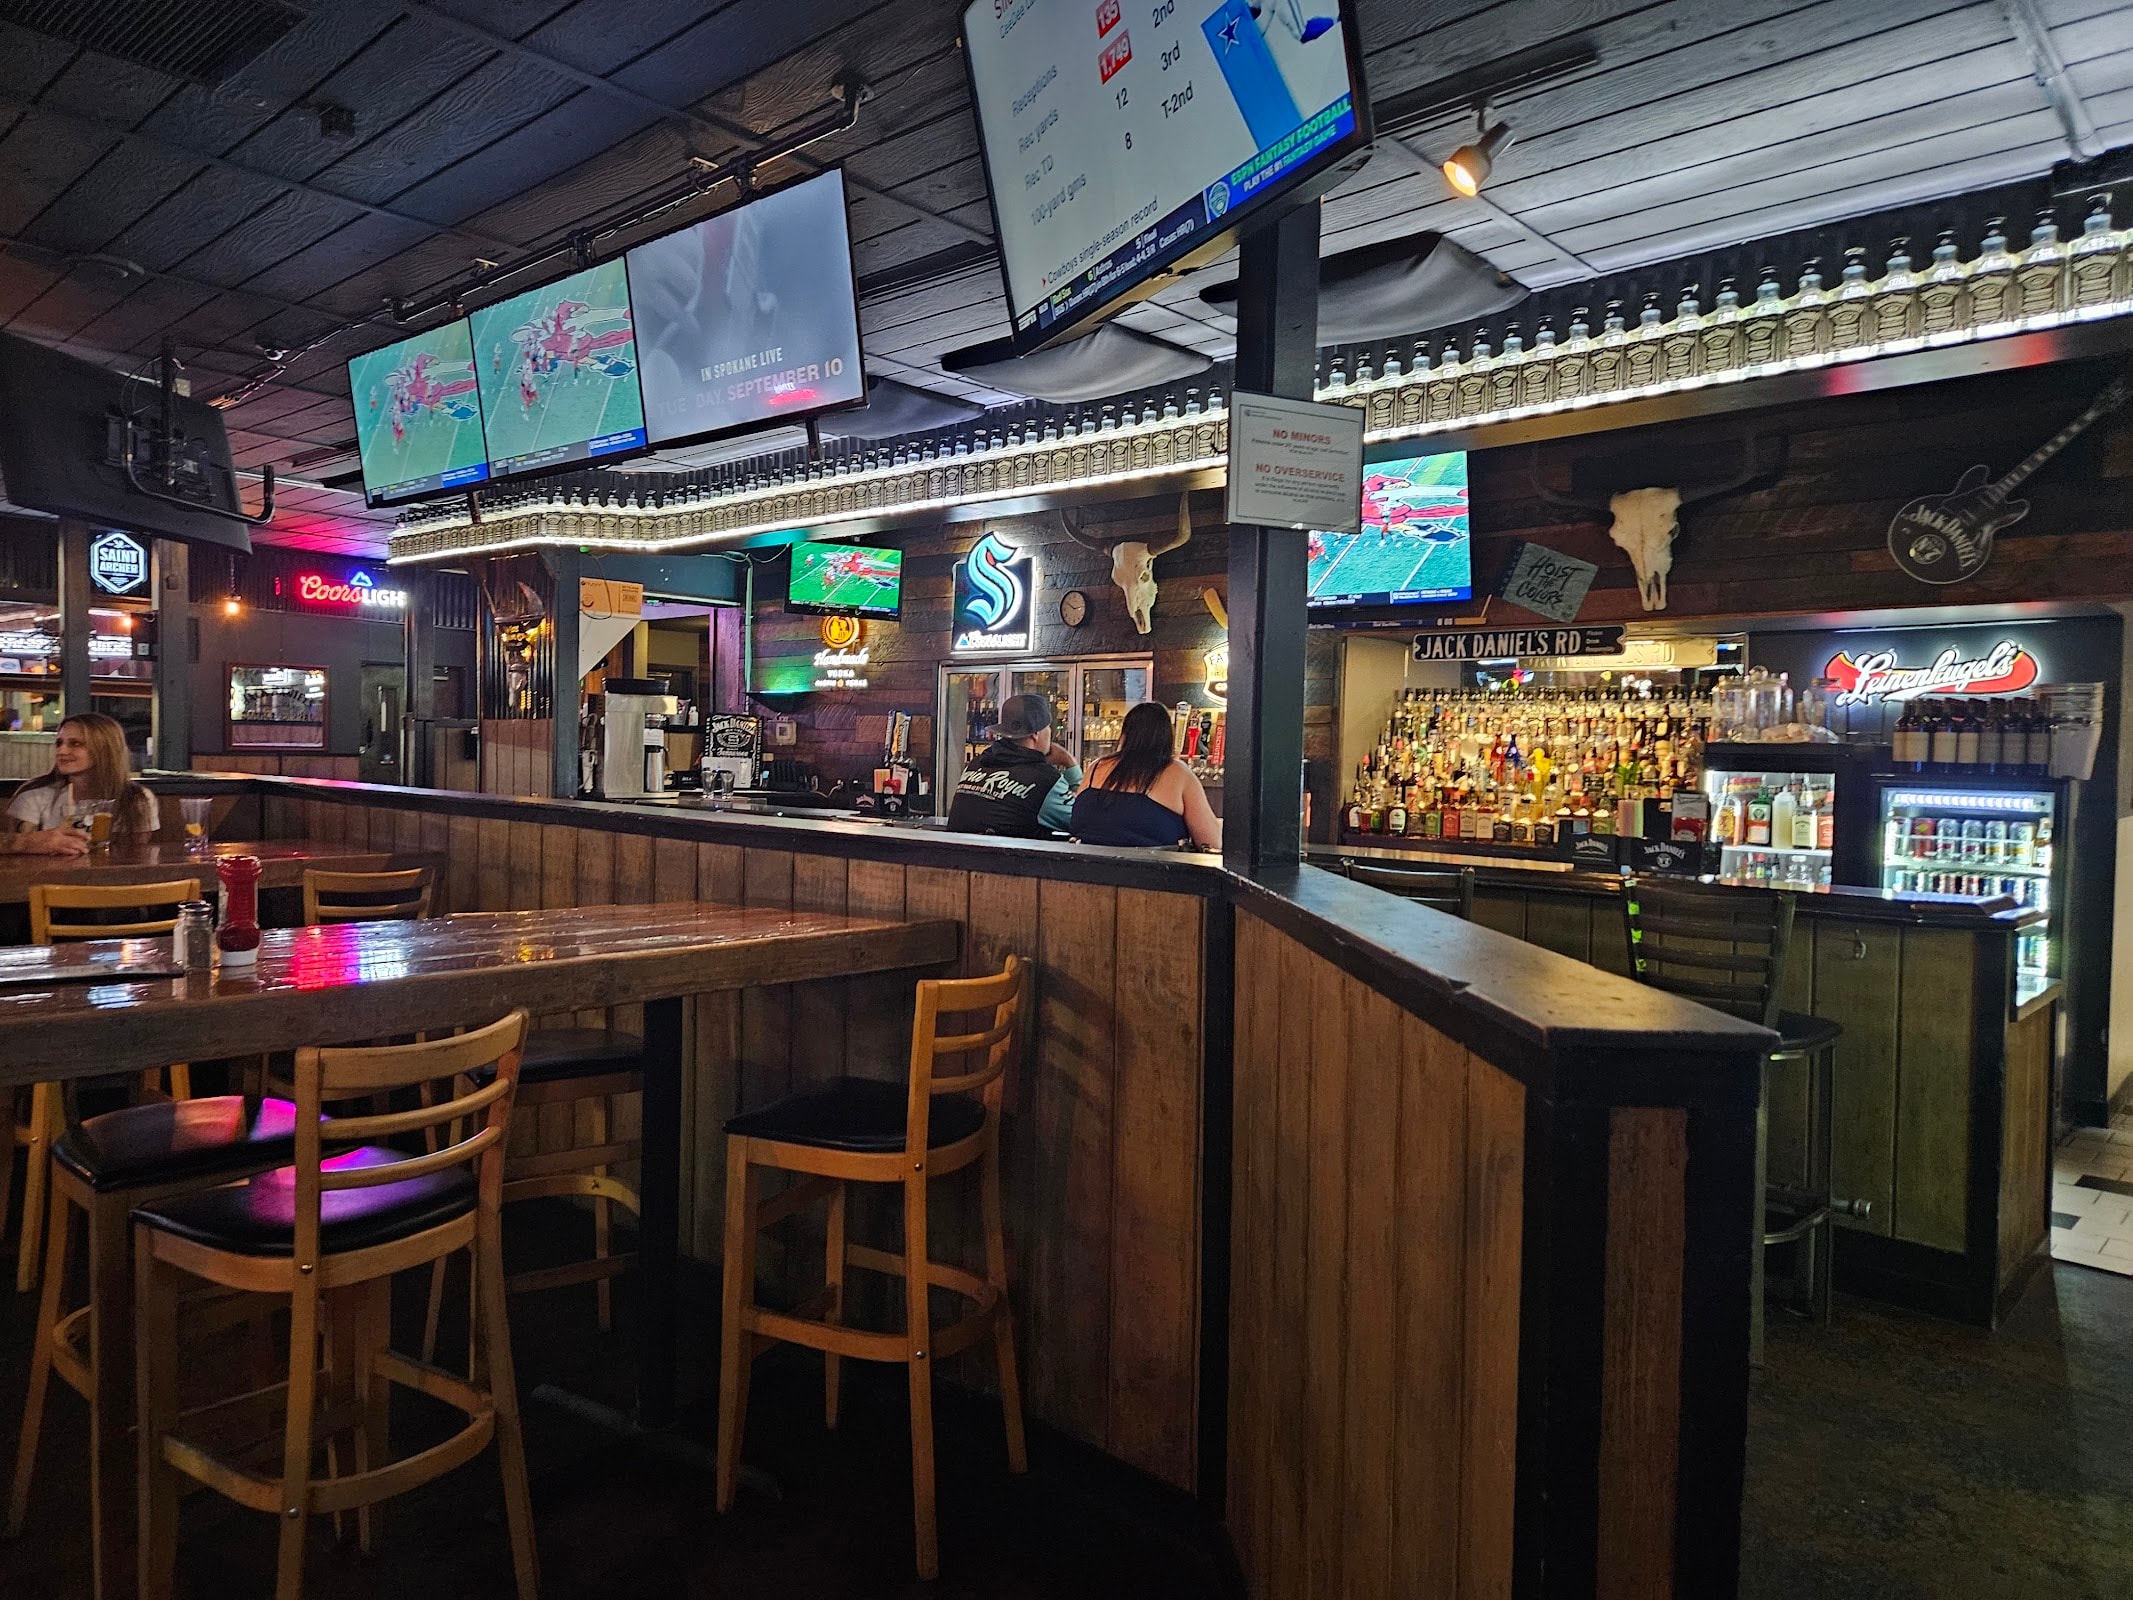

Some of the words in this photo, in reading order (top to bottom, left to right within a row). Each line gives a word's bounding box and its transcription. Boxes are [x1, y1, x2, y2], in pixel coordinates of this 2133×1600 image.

[1152, 0, 1175, 28] 2nd
[1100, 36, 1129, 76] 1,749
[1160, 40, 1181, 71] 3rd
[1012, 64, 1058, 118] Receptions
[1115, 87, 1129, 110] 12
[1161, 80, 1194, 119] T-2nd
[1124, 131, 1133, 150] 8
[1255, 132, 1297, 171] FANTASY
[1297, 98, 1352, 142] FOOTBALL
[1047, 255, 1079, 284] Cowboys
[1079, 219, 1130, 263] single-season
[1130, 195, 1158, 228] record
[701, 366, 712, 382] IN
[714, 354, 757, 379] SPOKANE
[760, 347, 783, 366] LIVE
[727, 363, 820, 401] SEPTEMBER
[824, 357, 843, 378] 10
[1273, 428, 1288, 440] NO
[1291, 430, 1332, 445] MINORS
[1255, 463, 1271, 474] NO
[1274, 465, 1345, 482] OVERSERVICE
[99, 547, 138, 563] SAINT
[99, 561, 139, 574] ARCHER
[1527, 555, 1584, 591] HOIST
[300, 575, 362, 603] Coors
[1421, 634, 1466, 660] JACK
[1472, 630, 1549, 658] DANIEL'S
[1555, 629, 1581, 655] RD
[827, 669, 855, 679] VODKA
[1836, 641, 2019, 707] Leinenkugel's
[985, 770, 1036, 799] Royal
